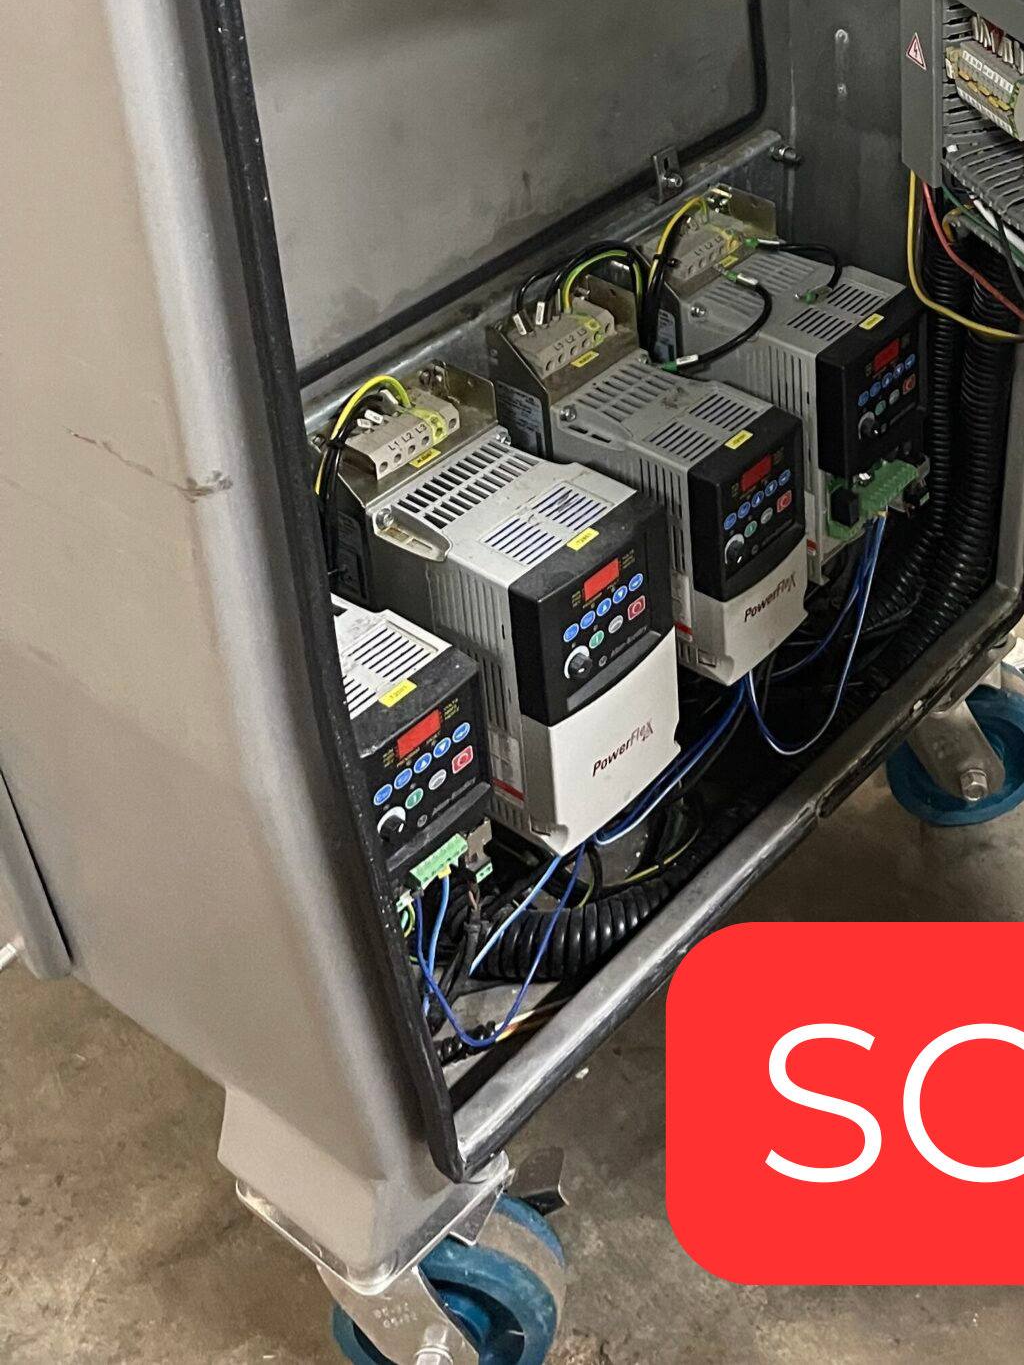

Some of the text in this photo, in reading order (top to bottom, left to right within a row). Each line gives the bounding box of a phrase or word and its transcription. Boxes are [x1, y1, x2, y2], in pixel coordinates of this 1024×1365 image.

[387, 423, 428, 451] L1 L2 L3
